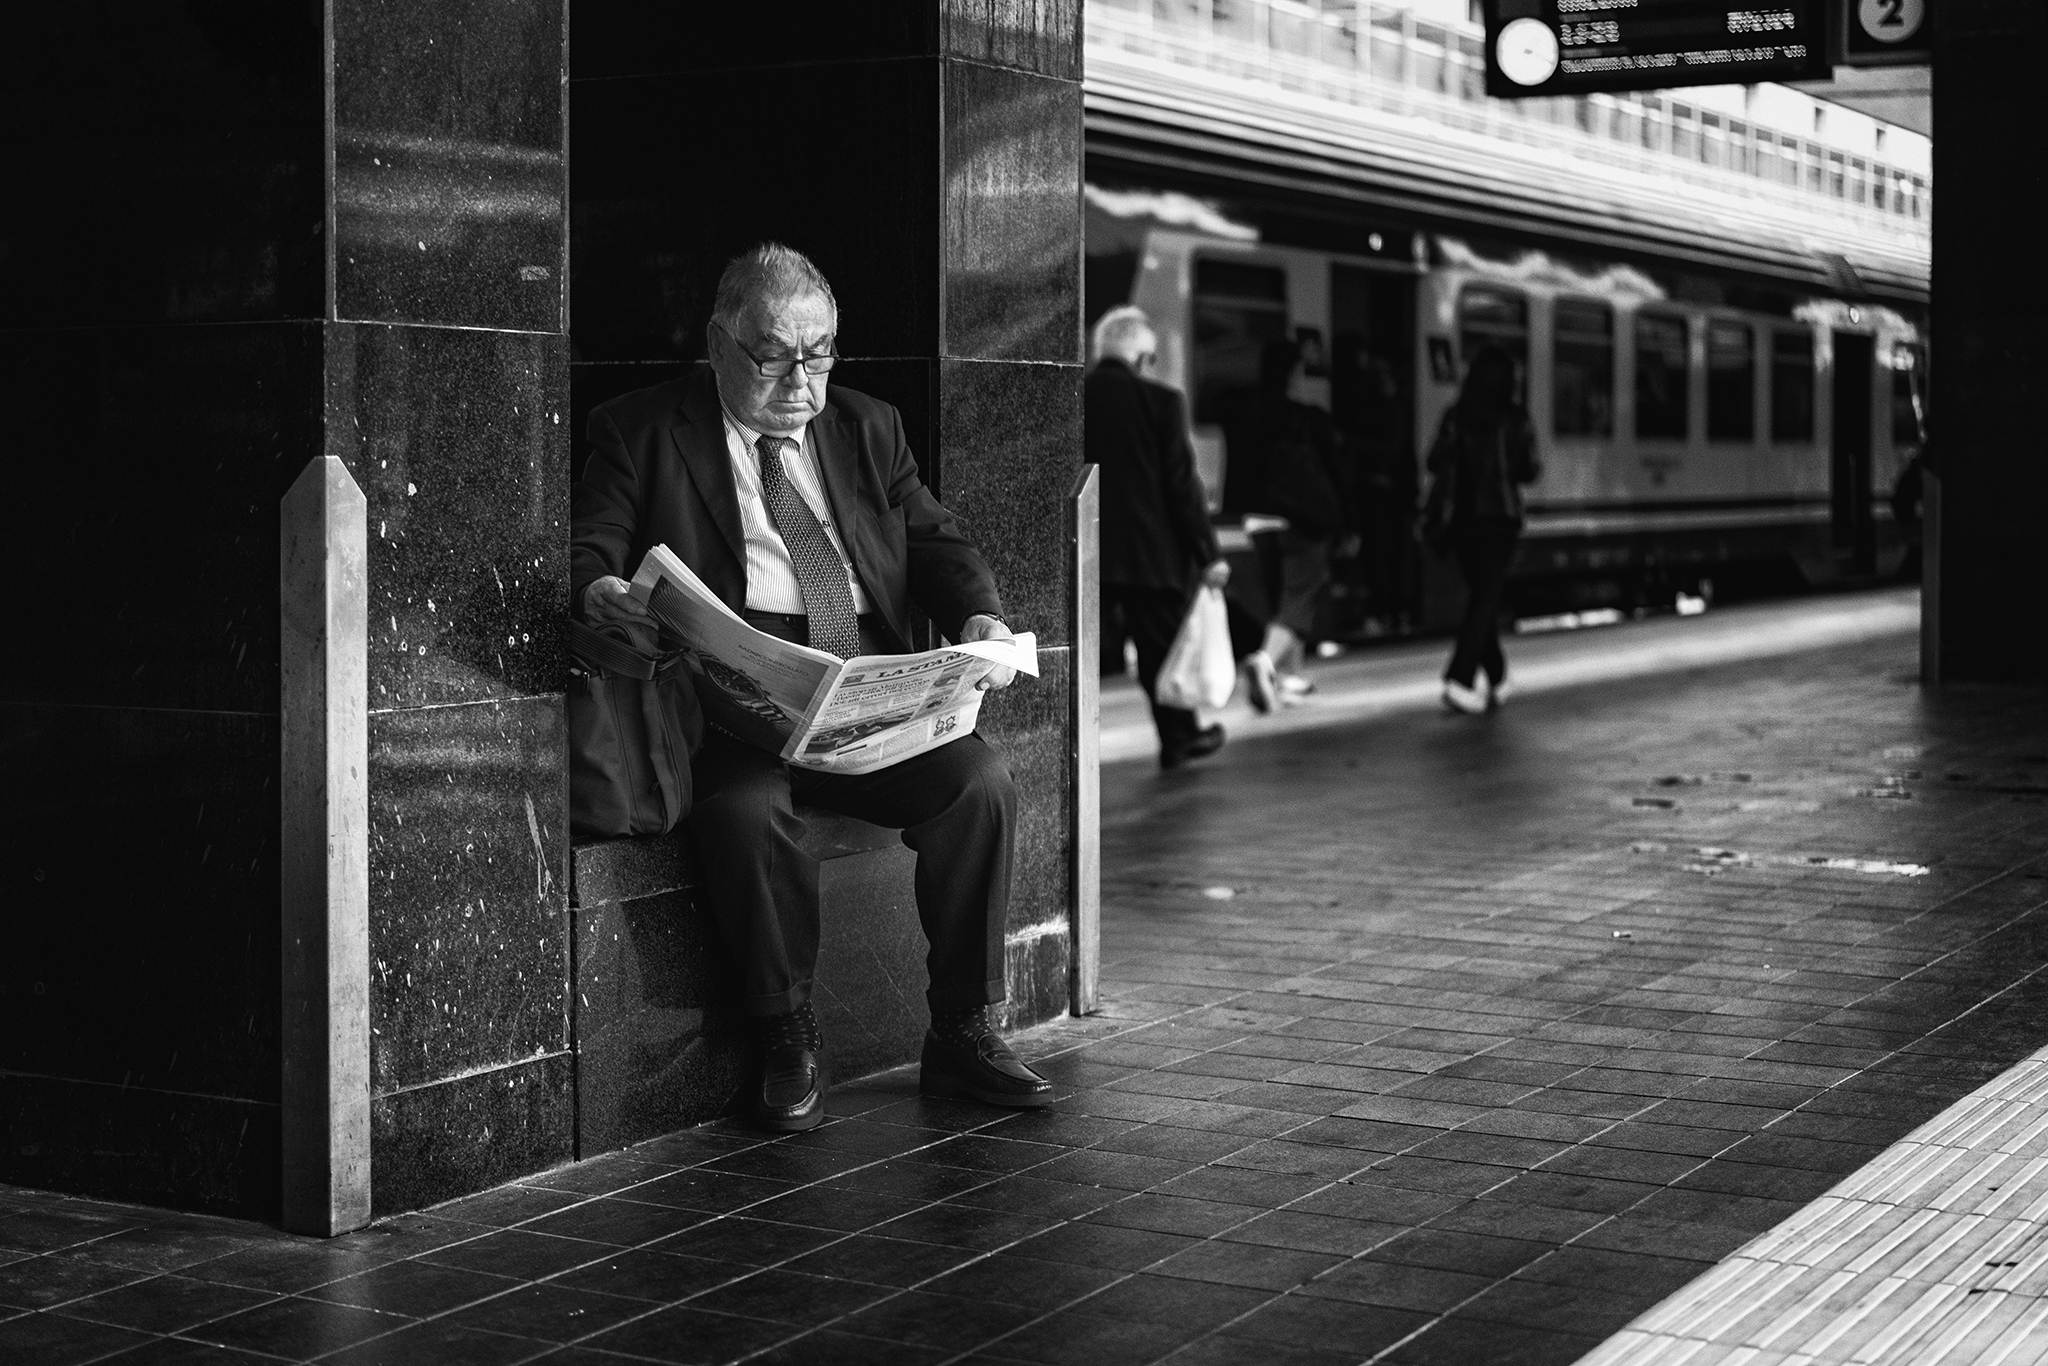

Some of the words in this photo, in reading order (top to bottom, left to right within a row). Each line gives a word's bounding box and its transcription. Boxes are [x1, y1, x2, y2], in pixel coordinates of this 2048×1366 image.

[876, 0, 904, 28] 2
[876, 668, 904, 678] LA
[906, 652, 967, 673] STAM
